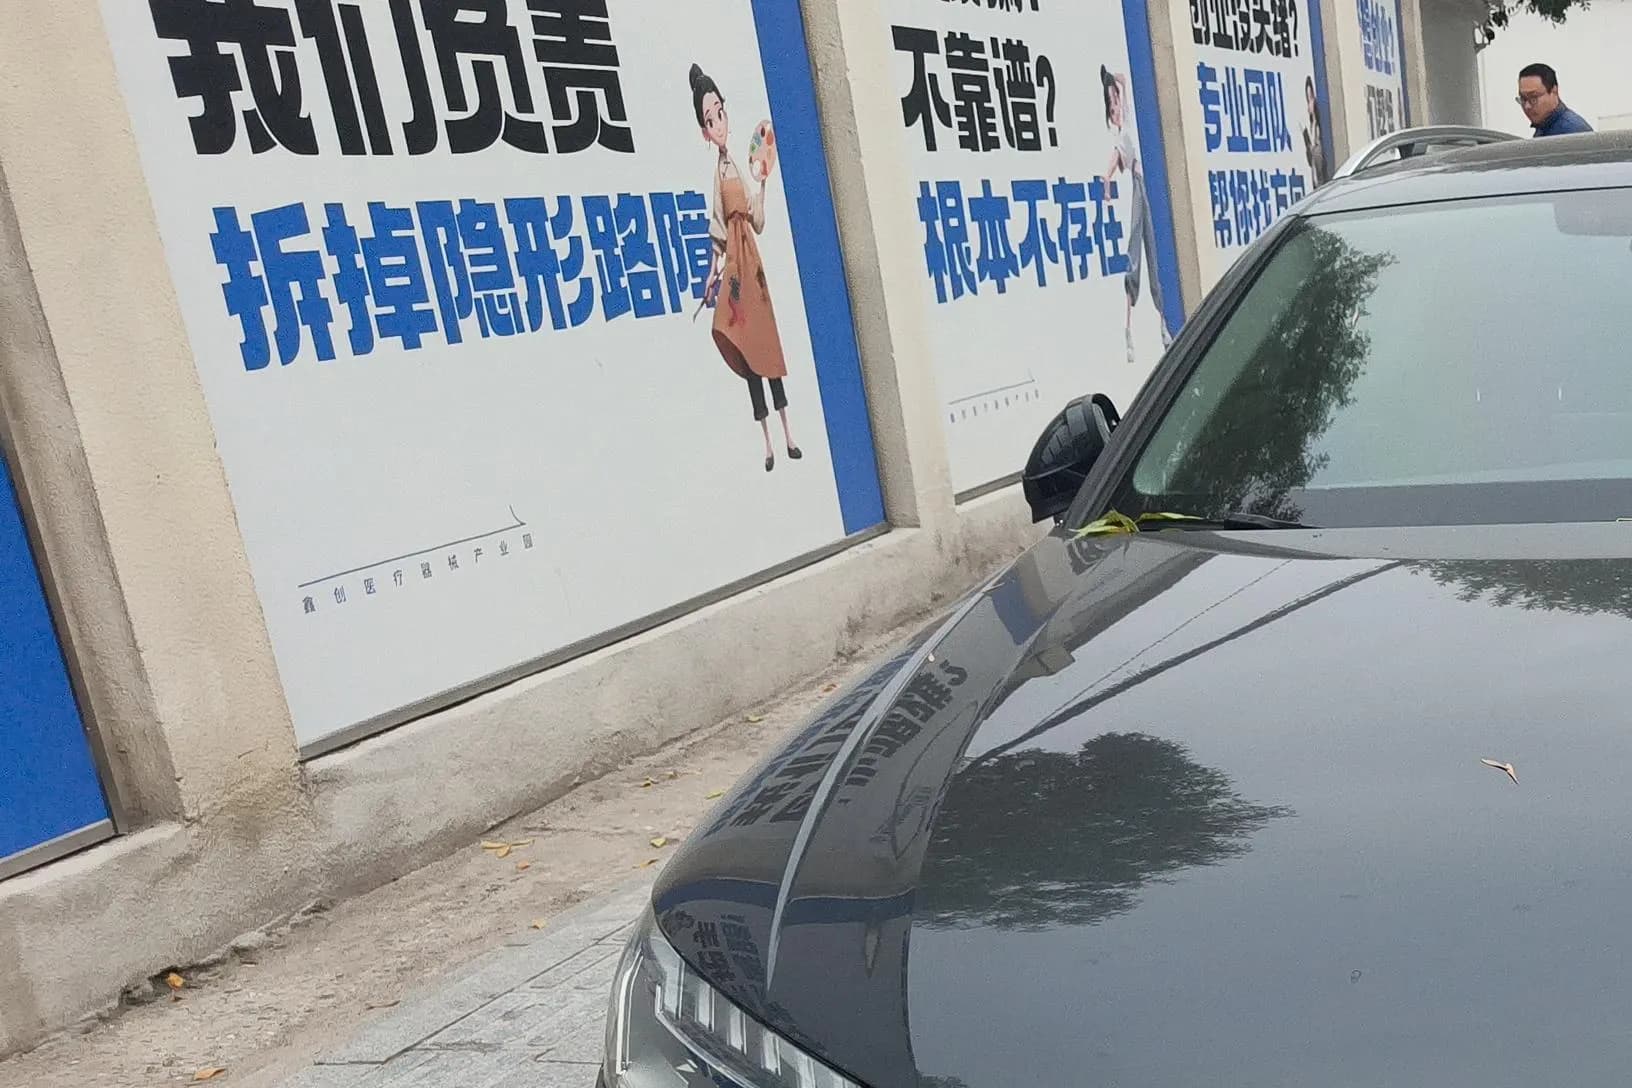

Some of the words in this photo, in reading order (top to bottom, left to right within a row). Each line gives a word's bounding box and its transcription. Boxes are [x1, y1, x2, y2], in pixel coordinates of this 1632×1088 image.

[148, 0, 635, 155] 我们负责
[891, 25, 1058, 151] 不靠谱?
[1197, 61, 1294, 152] 专业团队
[210, 190, 718, 371] 拆掉隐形路障
[917, 175, 1132, 303] 根本不存在
